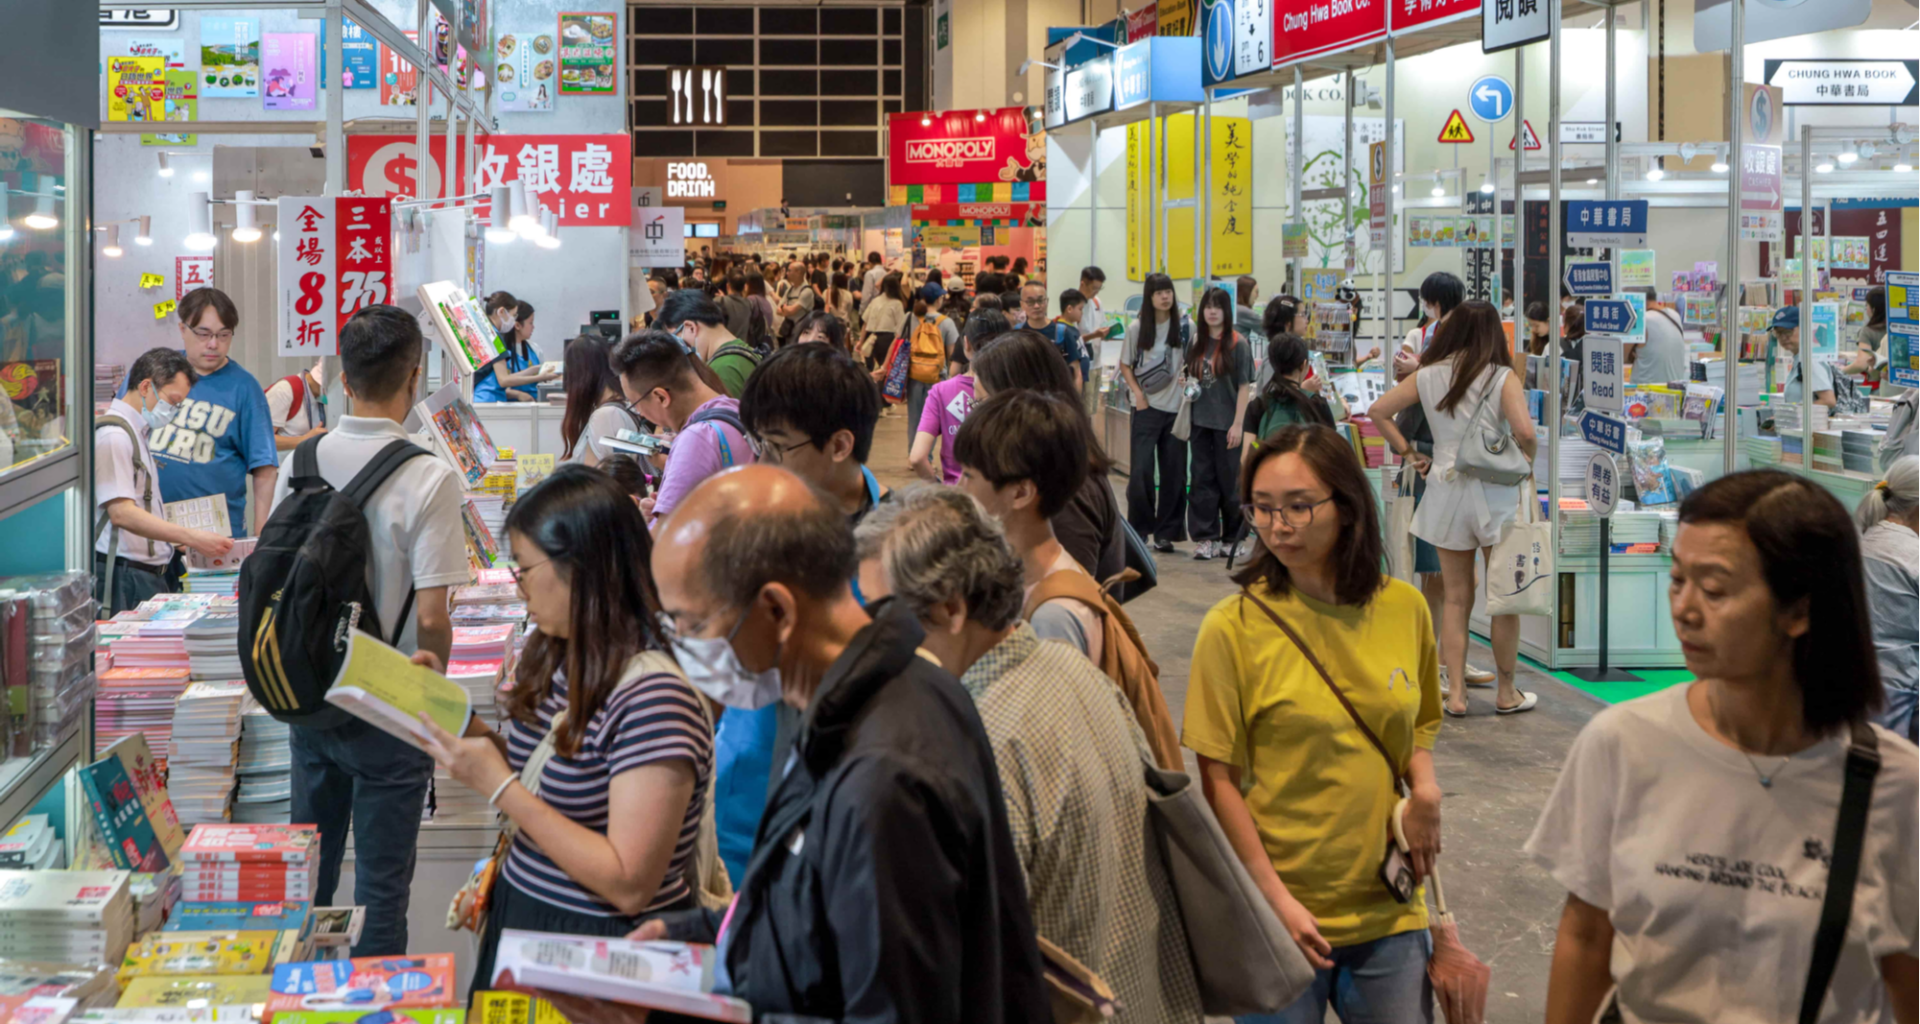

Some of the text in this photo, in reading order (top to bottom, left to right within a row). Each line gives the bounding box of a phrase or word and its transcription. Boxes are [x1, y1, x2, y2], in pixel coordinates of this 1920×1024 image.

[1283, 11, 1308, 32] Chung
[1310, 4, 1329, 24] Hwa
[1331, 0, 1353, 18] Book
[1258, 41, 1264, 63] 6
[1788, 70, 1897, 78] CHUNG HWA BOOK
[1318, 89, 1344, 101] CO.
[1816, 84, 1869, 97] 中華書局
[909, 141, 992, 159] MONOPOLY
[465, 143, 614, 195] 收銀處
[667, 162, 712, 179] FOOD.
[1744, 150, 1777, 175] 收銀處
[667, 180, 715, 197] DRINK
[961, 206, 1008, 214] MONOPOLY
[1580, 207, 1631, 226] 中華書局
[1593, 306, 1619, 320] 書局街
[1591, 351, 1615, 376] 閱讀
[1592, 381, 1614, 398] Read
[1589, 432, 1601, 444] Chung
[1609, 439, 1619, 449] Book
[1731, 859, 1752, 875] JOE
